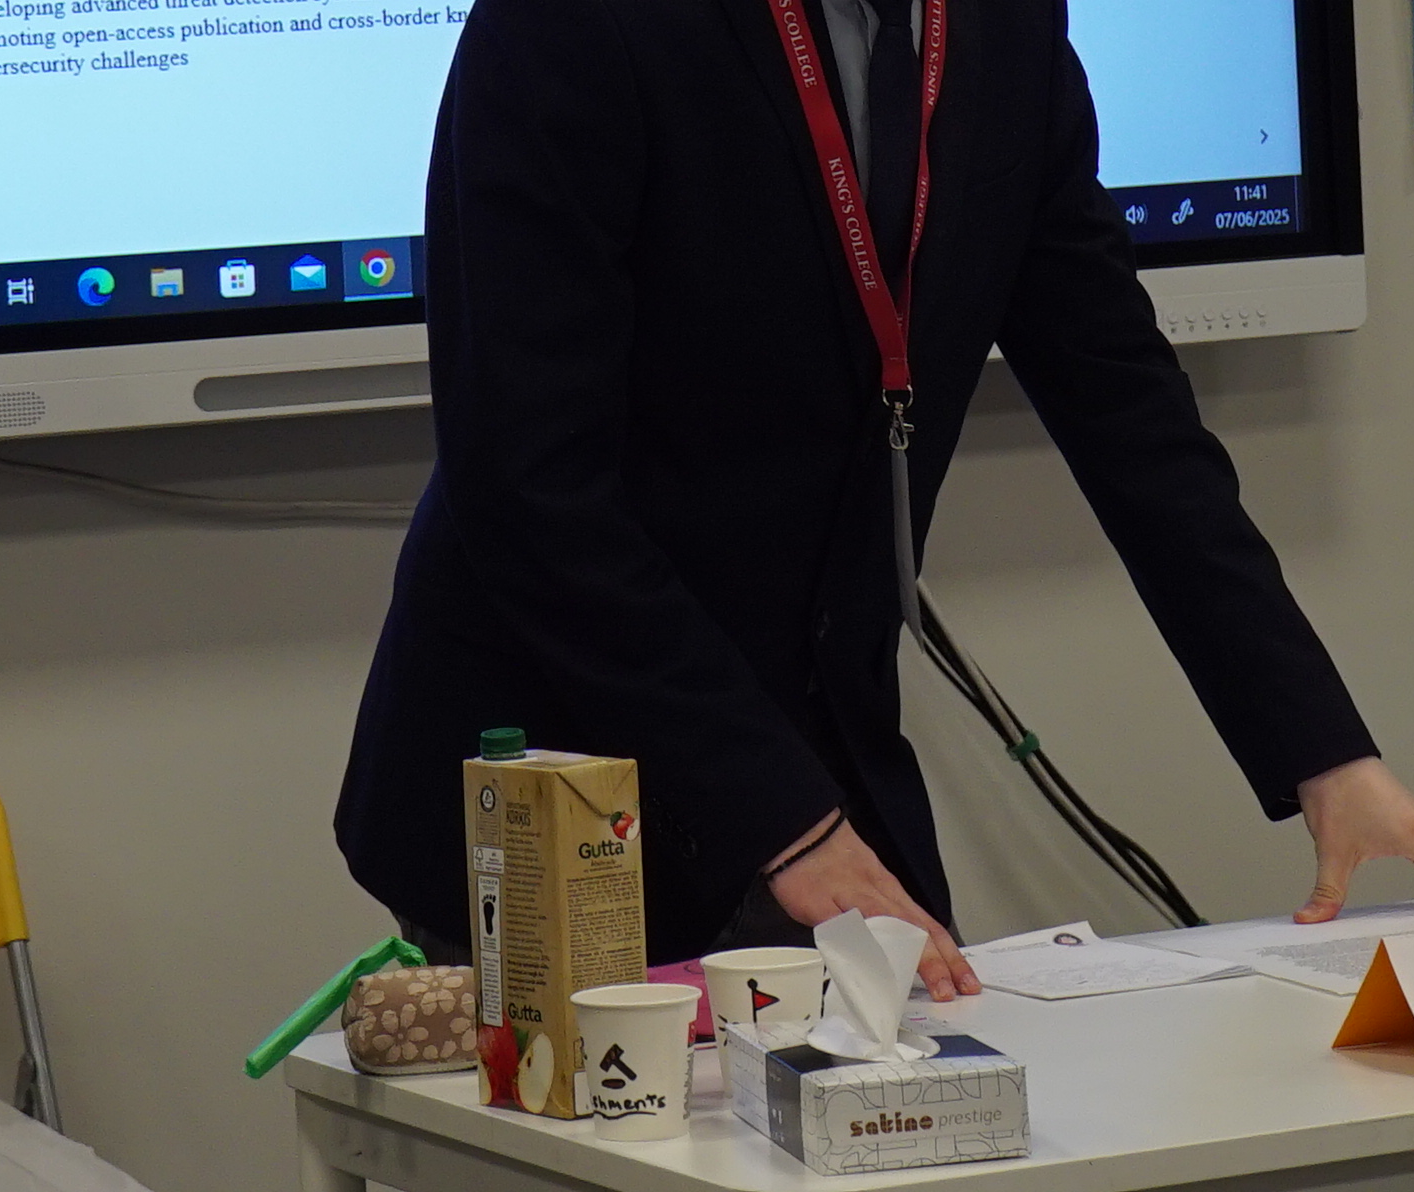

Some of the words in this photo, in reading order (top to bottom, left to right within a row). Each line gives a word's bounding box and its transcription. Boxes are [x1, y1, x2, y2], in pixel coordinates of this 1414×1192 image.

[783, 11, 818, 89] COLLEGE
[1233, 183, 1269, 201] 11:41
[827, 157, 856, 215] KING'S
[844, 216, 878, 292] COLLEGE
[1214, 207, 1290, 230] 07/06/2025
[577, 840, 625, 860] Gutta
[507, 1003, 543, 1024] Gutta
[849, 1110, 934, 1138] satino
[937, 1107, 1003, 1131] prestige
